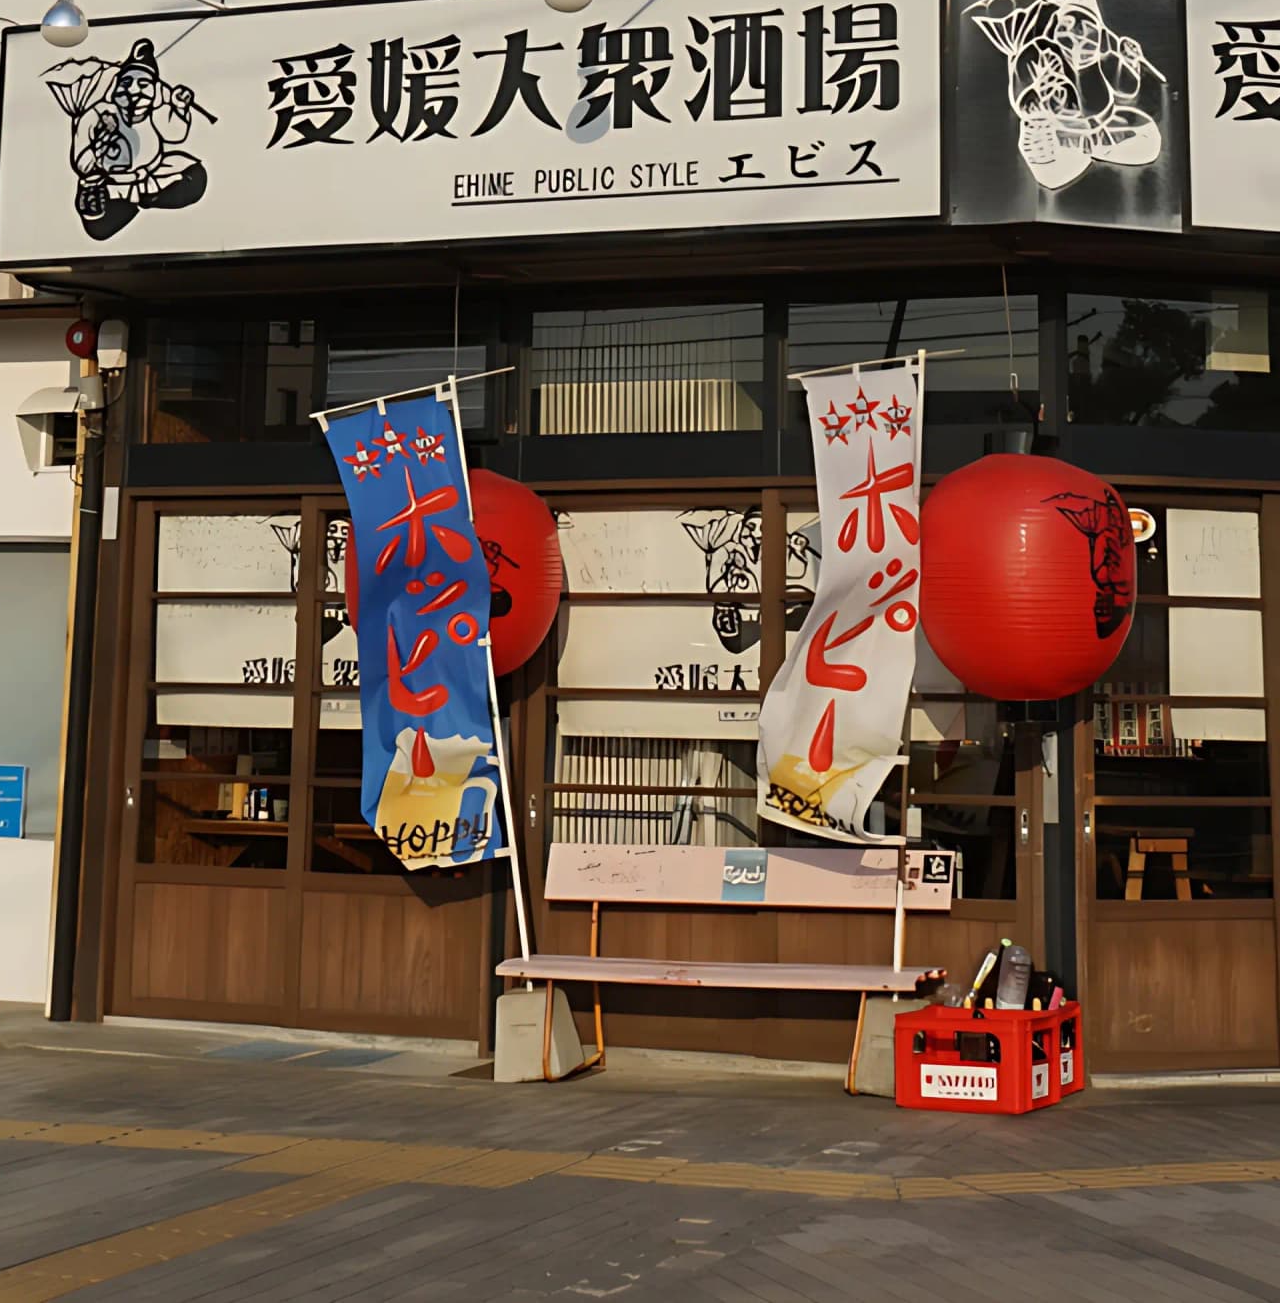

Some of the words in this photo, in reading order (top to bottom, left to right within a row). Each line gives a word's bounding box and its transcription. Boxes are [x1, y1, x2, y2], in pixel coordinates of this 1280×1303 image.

[266, 2, 901, 150] 愛媛大衆酒場
[534, 165, 616, 194] PUBLIC
[630, 160, 700, 189] STYLE
[718, 140, 884, 183] エビス
